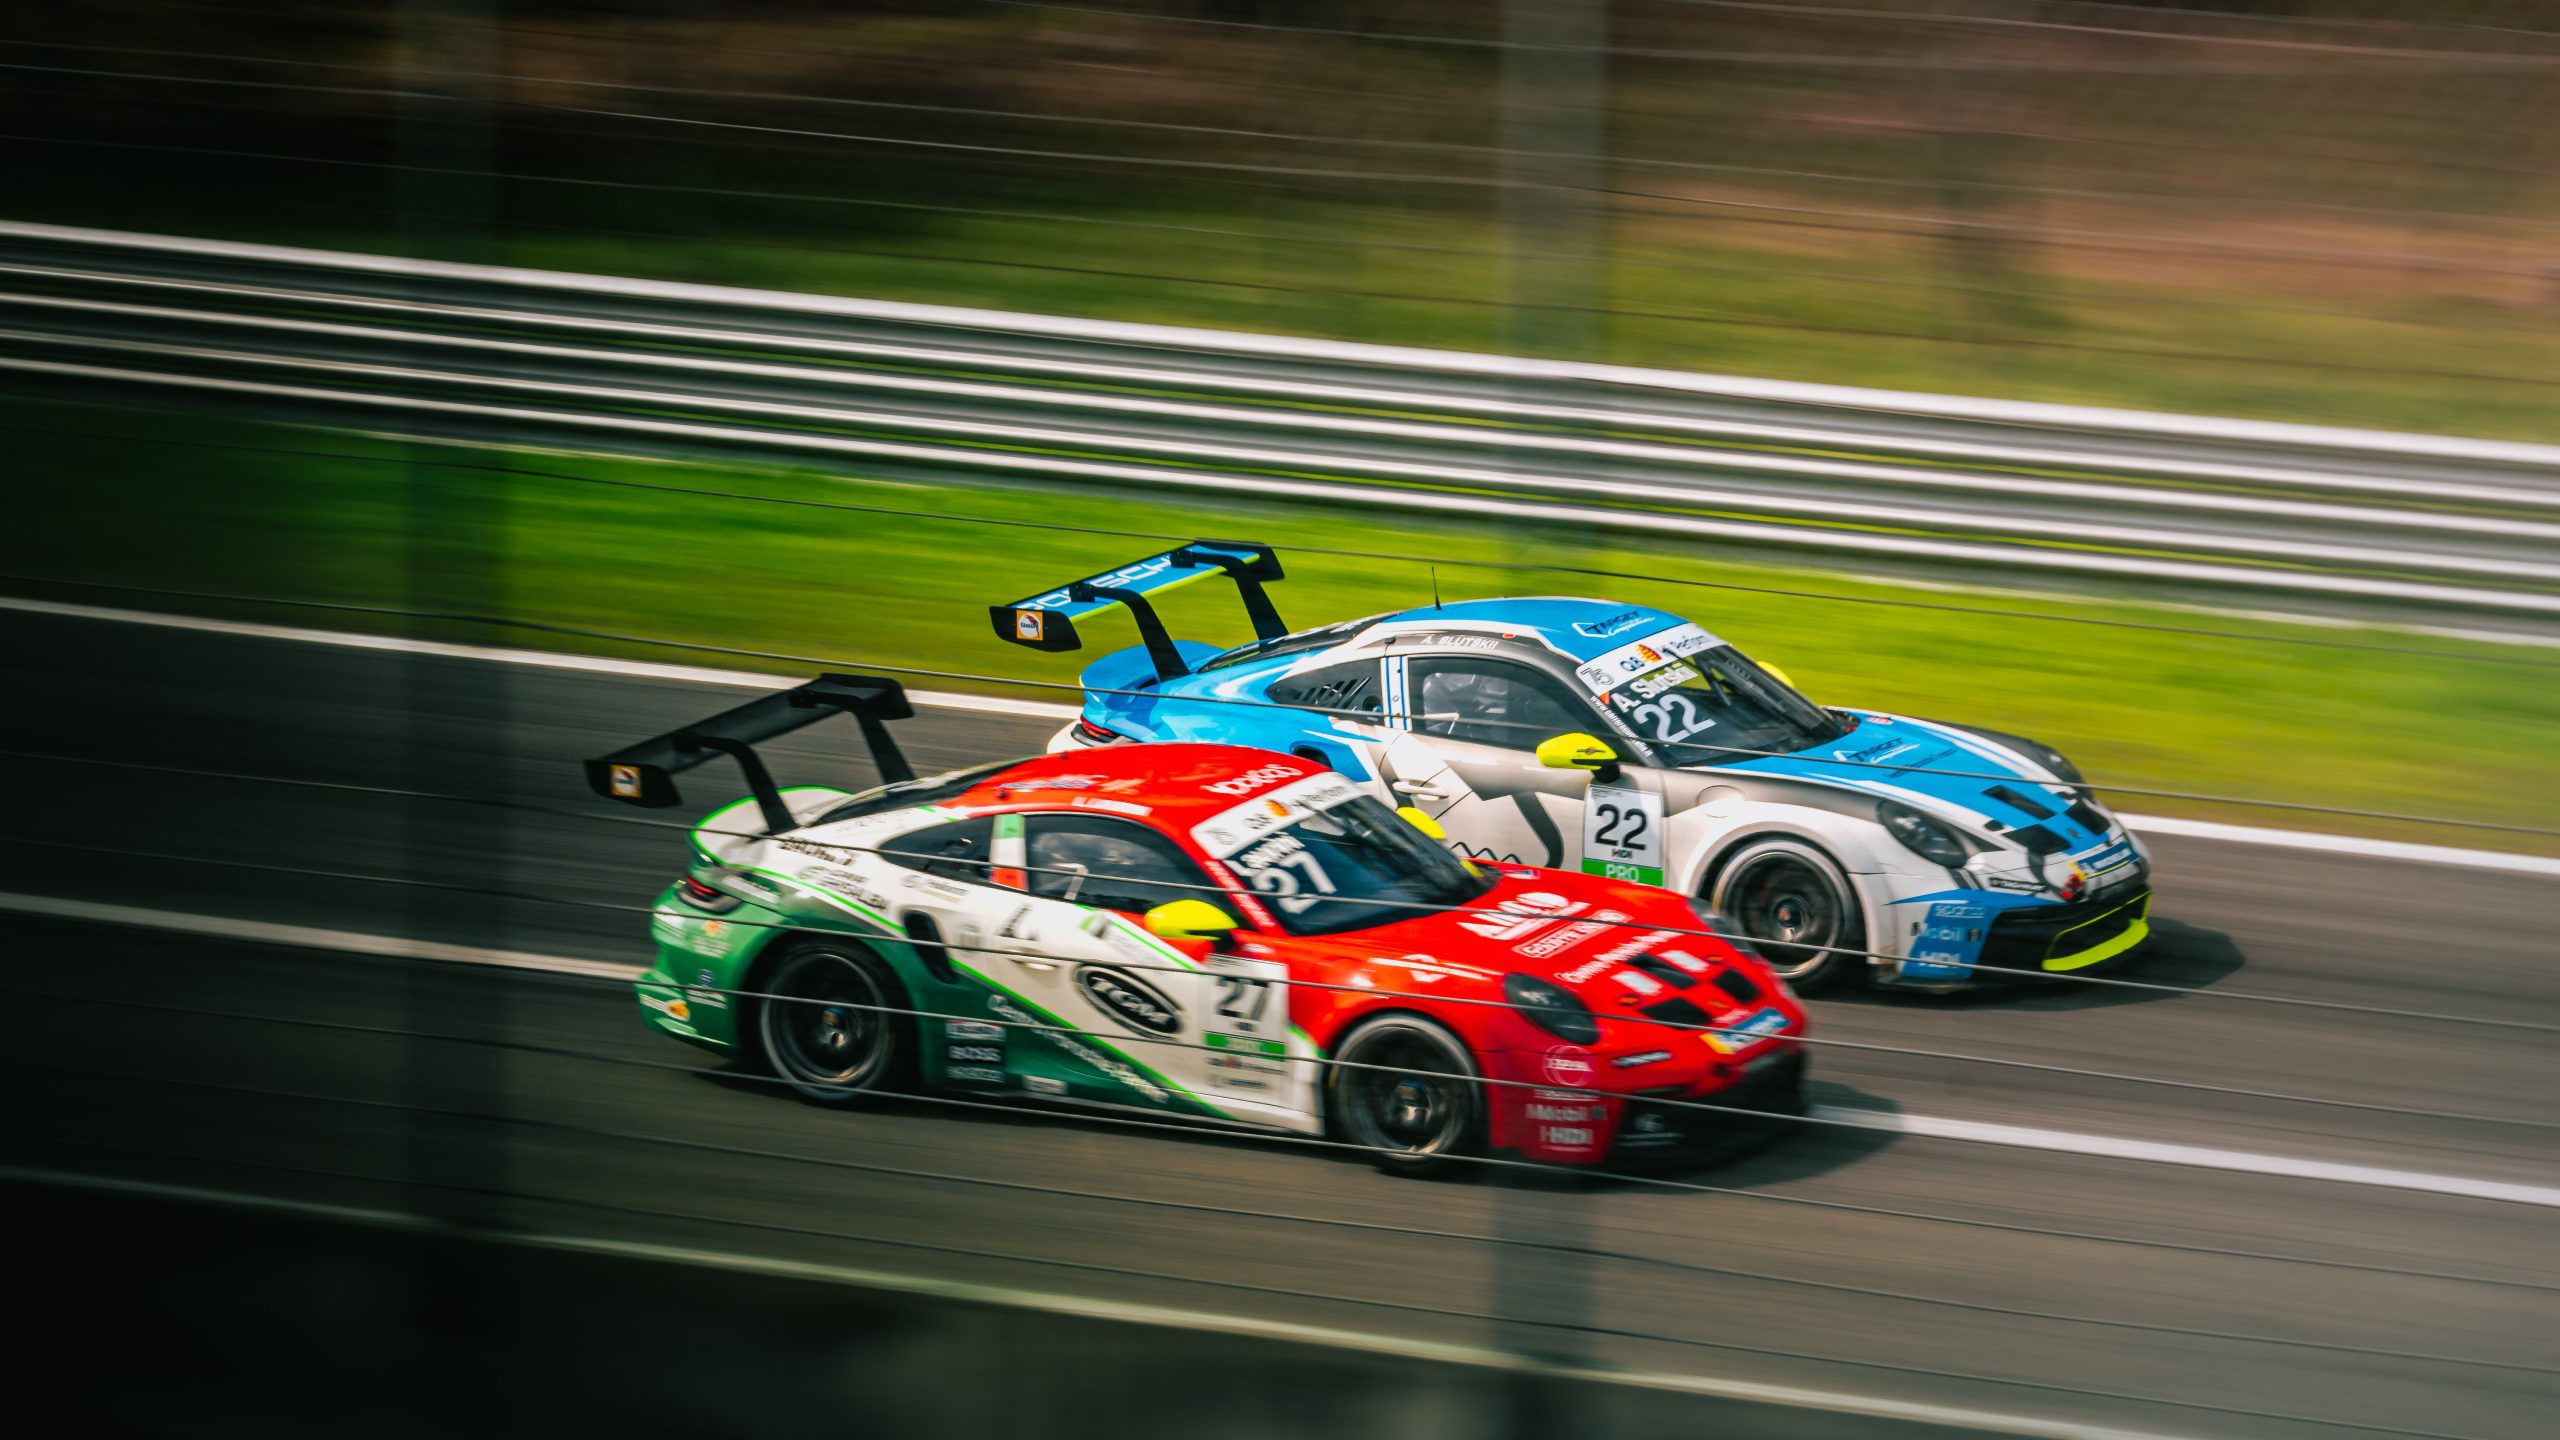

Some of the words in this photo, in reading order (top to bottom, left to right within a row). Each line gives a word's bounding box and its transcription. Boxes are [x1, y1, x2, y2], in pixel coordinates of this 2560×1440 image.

[1633, 694, 1718, 747] 22
[1594, 803, 1648, 851] 22
[1252, 851, 1338, 915] 27
[1605, 863, 1640, 883] PRO
[1215, 976, 1271, 1021] 27
